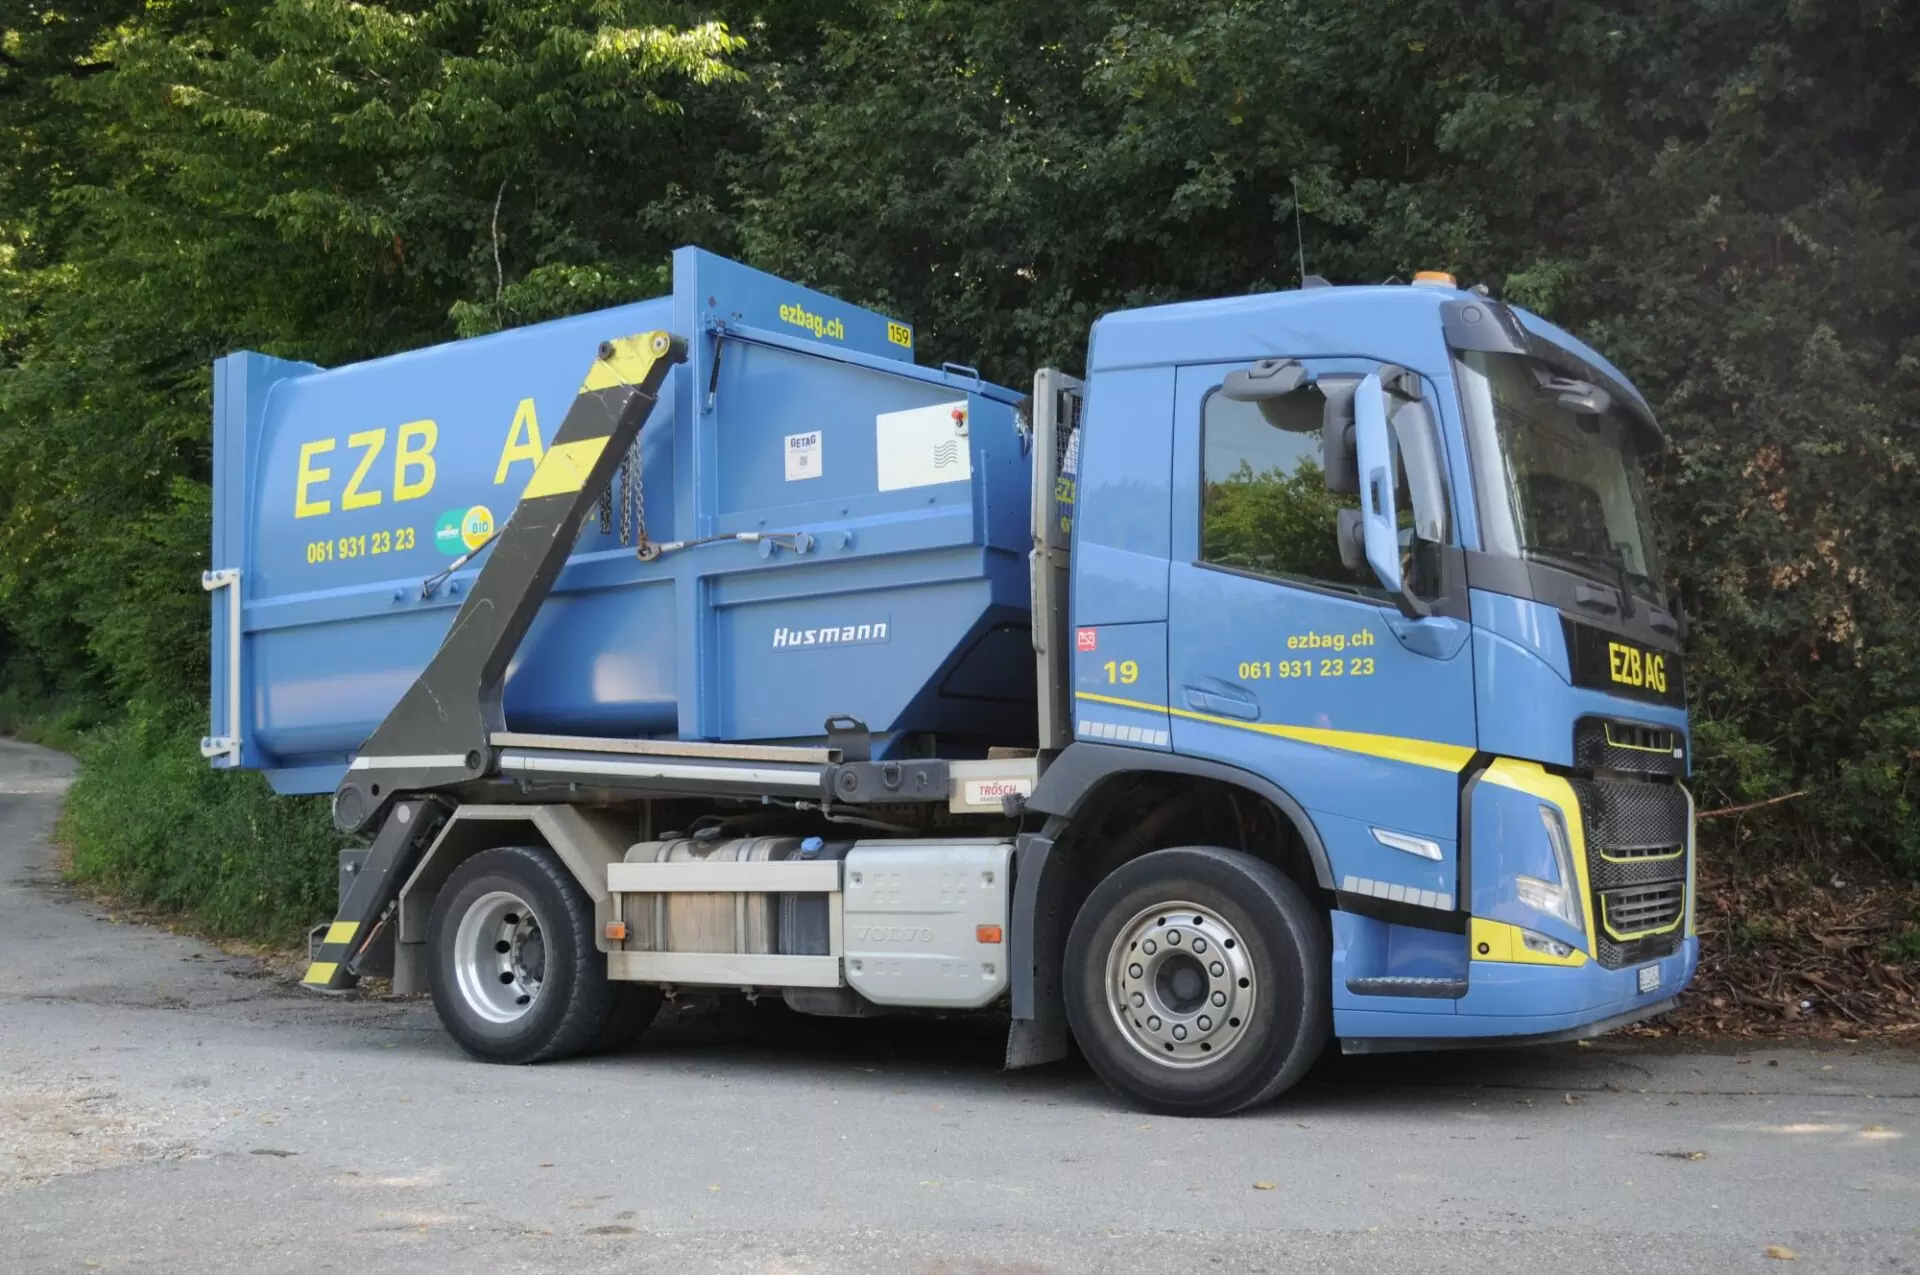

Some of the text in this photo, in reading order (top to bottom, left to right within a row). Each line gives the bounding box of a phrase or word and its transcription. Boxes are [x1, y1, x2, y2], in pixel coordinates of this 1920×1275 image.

[779, 303, 844, 340] ezbag.ch
[889, 323, 909, 344] 159
[790, 434, 816, 448] GETAG
[295, 419, 438, 519] EZB
[472, 521, 489, 533] BIO
[307, 542, 334, 564] 061
[338, 535, 365, 559] 931
[371, 529, 391, 554] 23
[395, 526, 415, 550] 23
[772, 623, 887, 648] Husmann
[1287, 628, 1374, 651] ezbag.ch
[1103, 660, 1139, 685] 19
[1238, 657, 1375, 679] 061 931 23 23
[1609, 642, 1666, 693] EZB AG
[852, 926, 936, 943] VOLVO
